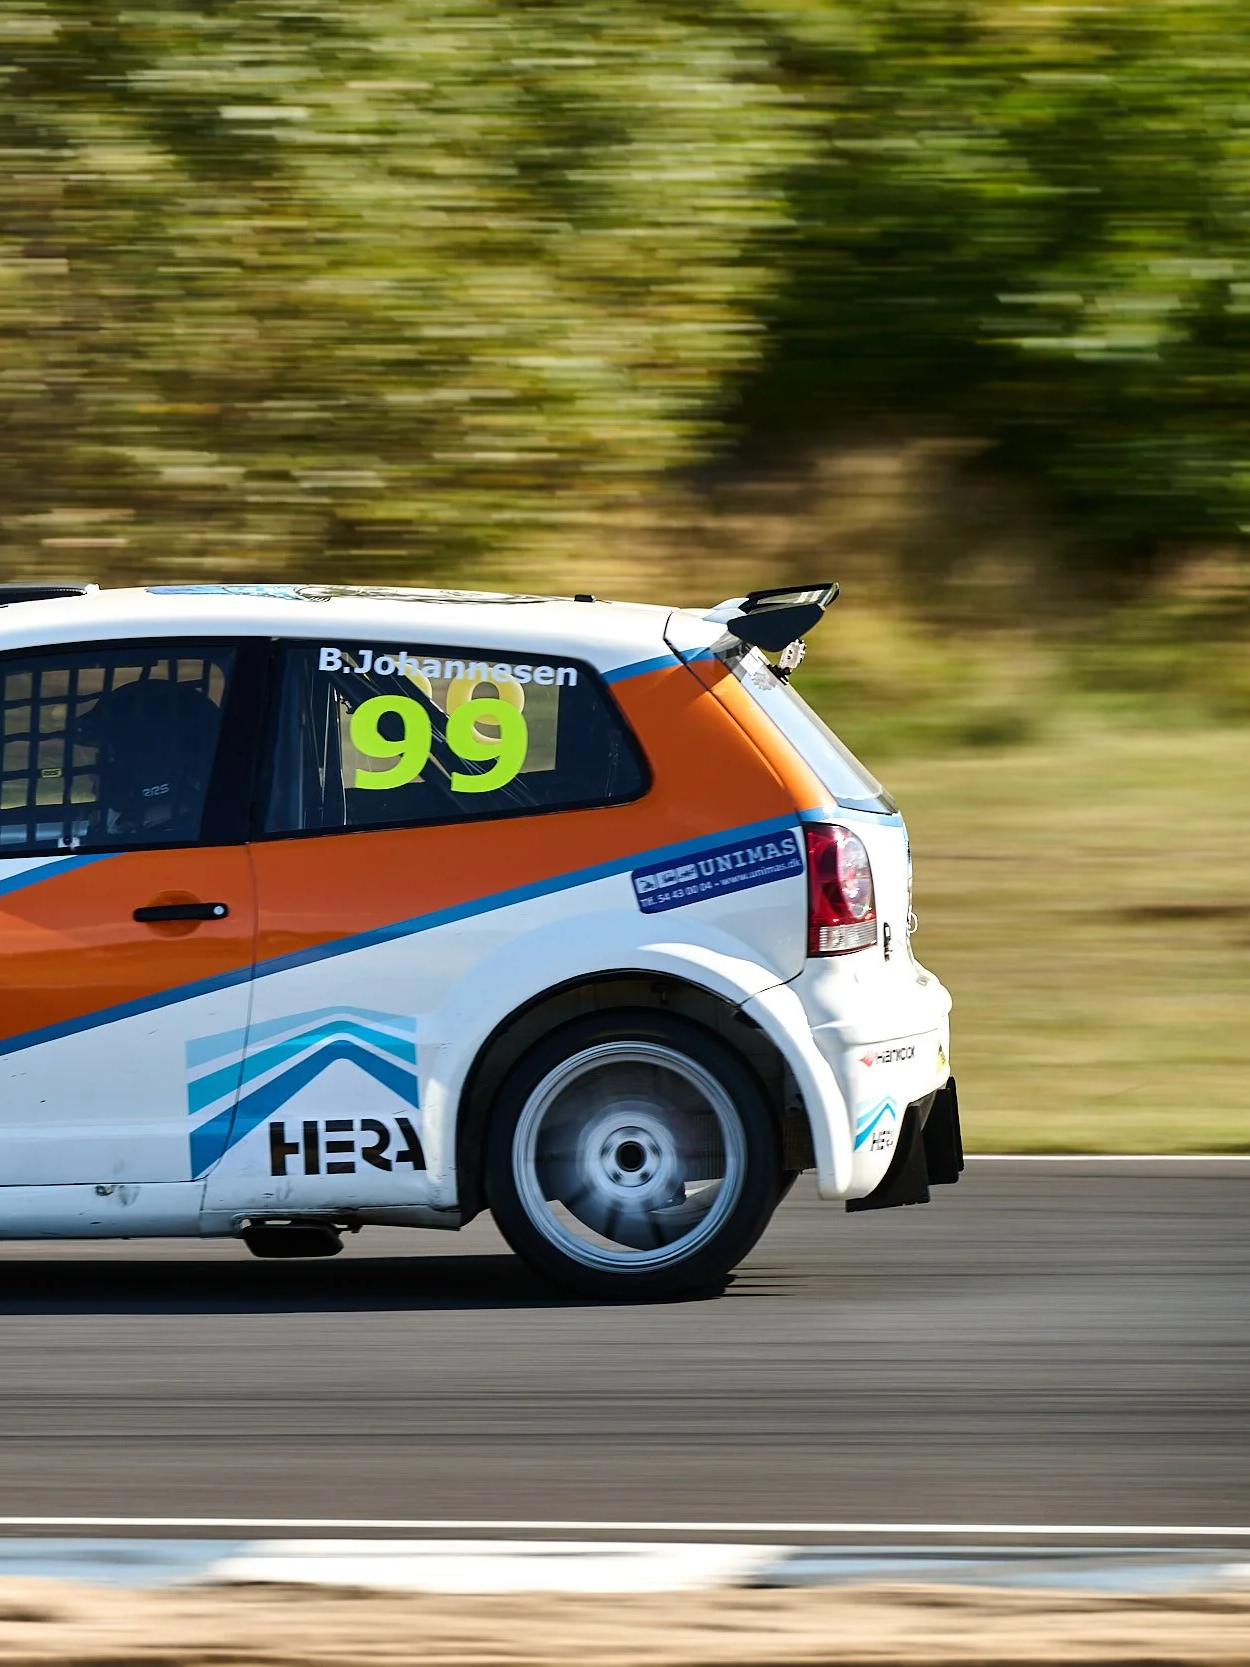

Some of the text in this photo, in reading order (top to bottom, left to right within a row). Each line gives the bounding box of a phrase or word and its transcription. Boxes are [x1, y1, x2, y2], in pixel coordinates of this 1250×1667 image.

[318, 647, 578, 687] B.Johannesen
[350, 694, 528, 793] 99
[697, 837, 797, 877] UNIMAS
[269, 1117, 427, 1177] HERA
